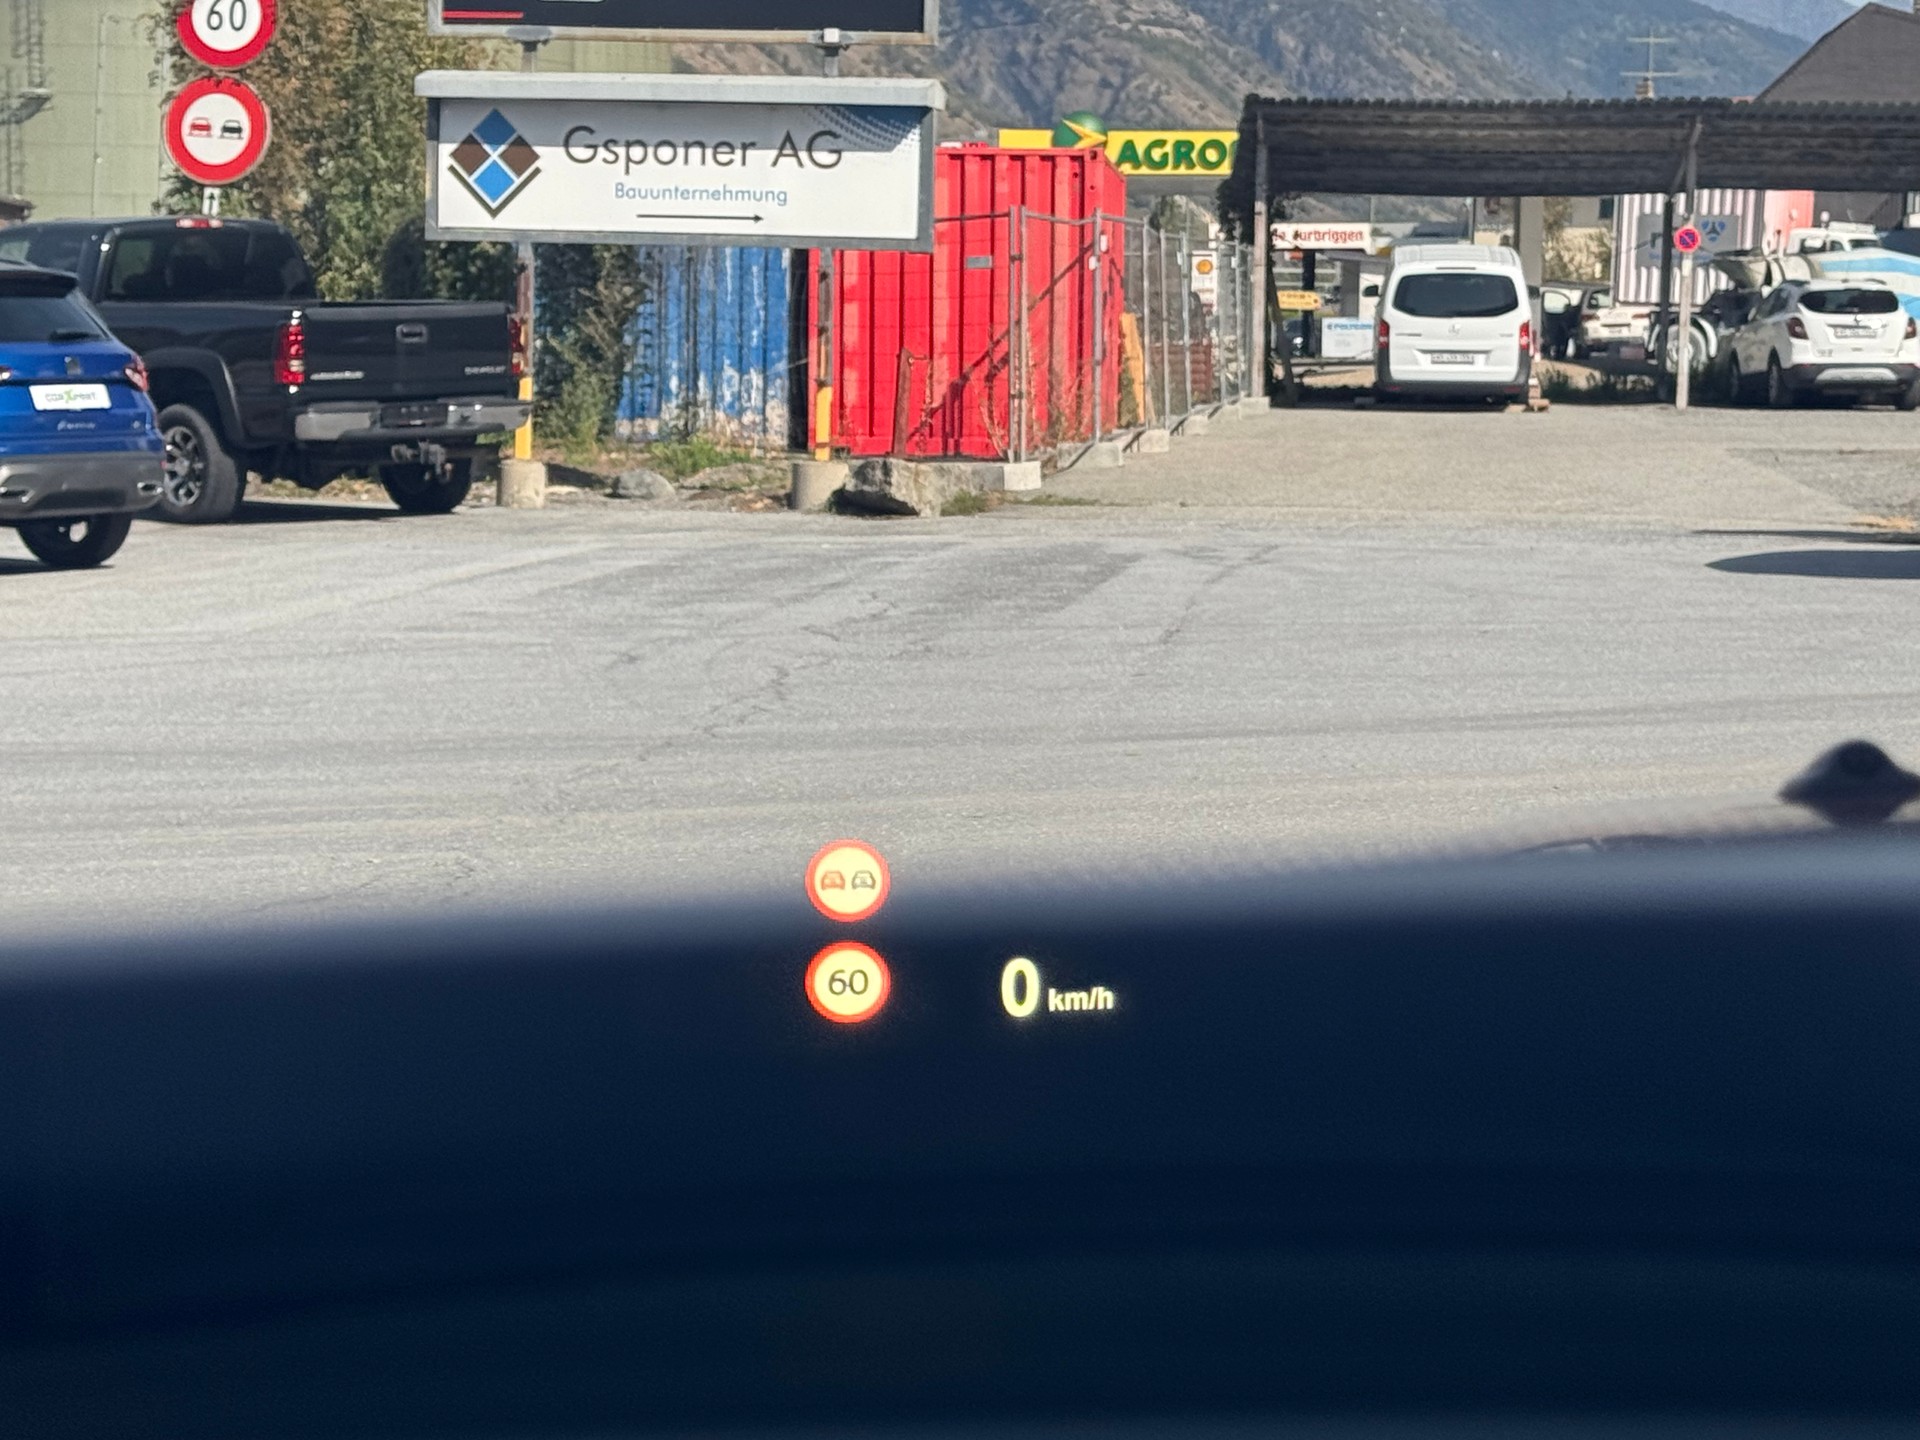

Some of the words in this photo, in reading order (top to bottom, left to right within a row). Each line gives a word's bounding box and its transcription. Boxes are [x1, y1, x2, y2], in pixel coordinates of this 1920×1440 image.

[206, 0, 247, 31] 60
[562, 125, 757, 175] Gsponer
[770, 129, 843, 169] AG
[614, 182, 788, 206] Bauunternehmung
[828, 969, 869, 995] 60
[1001, 957, 1040, 1018] 0
[1048, 986, 1114, 1012] km/h
